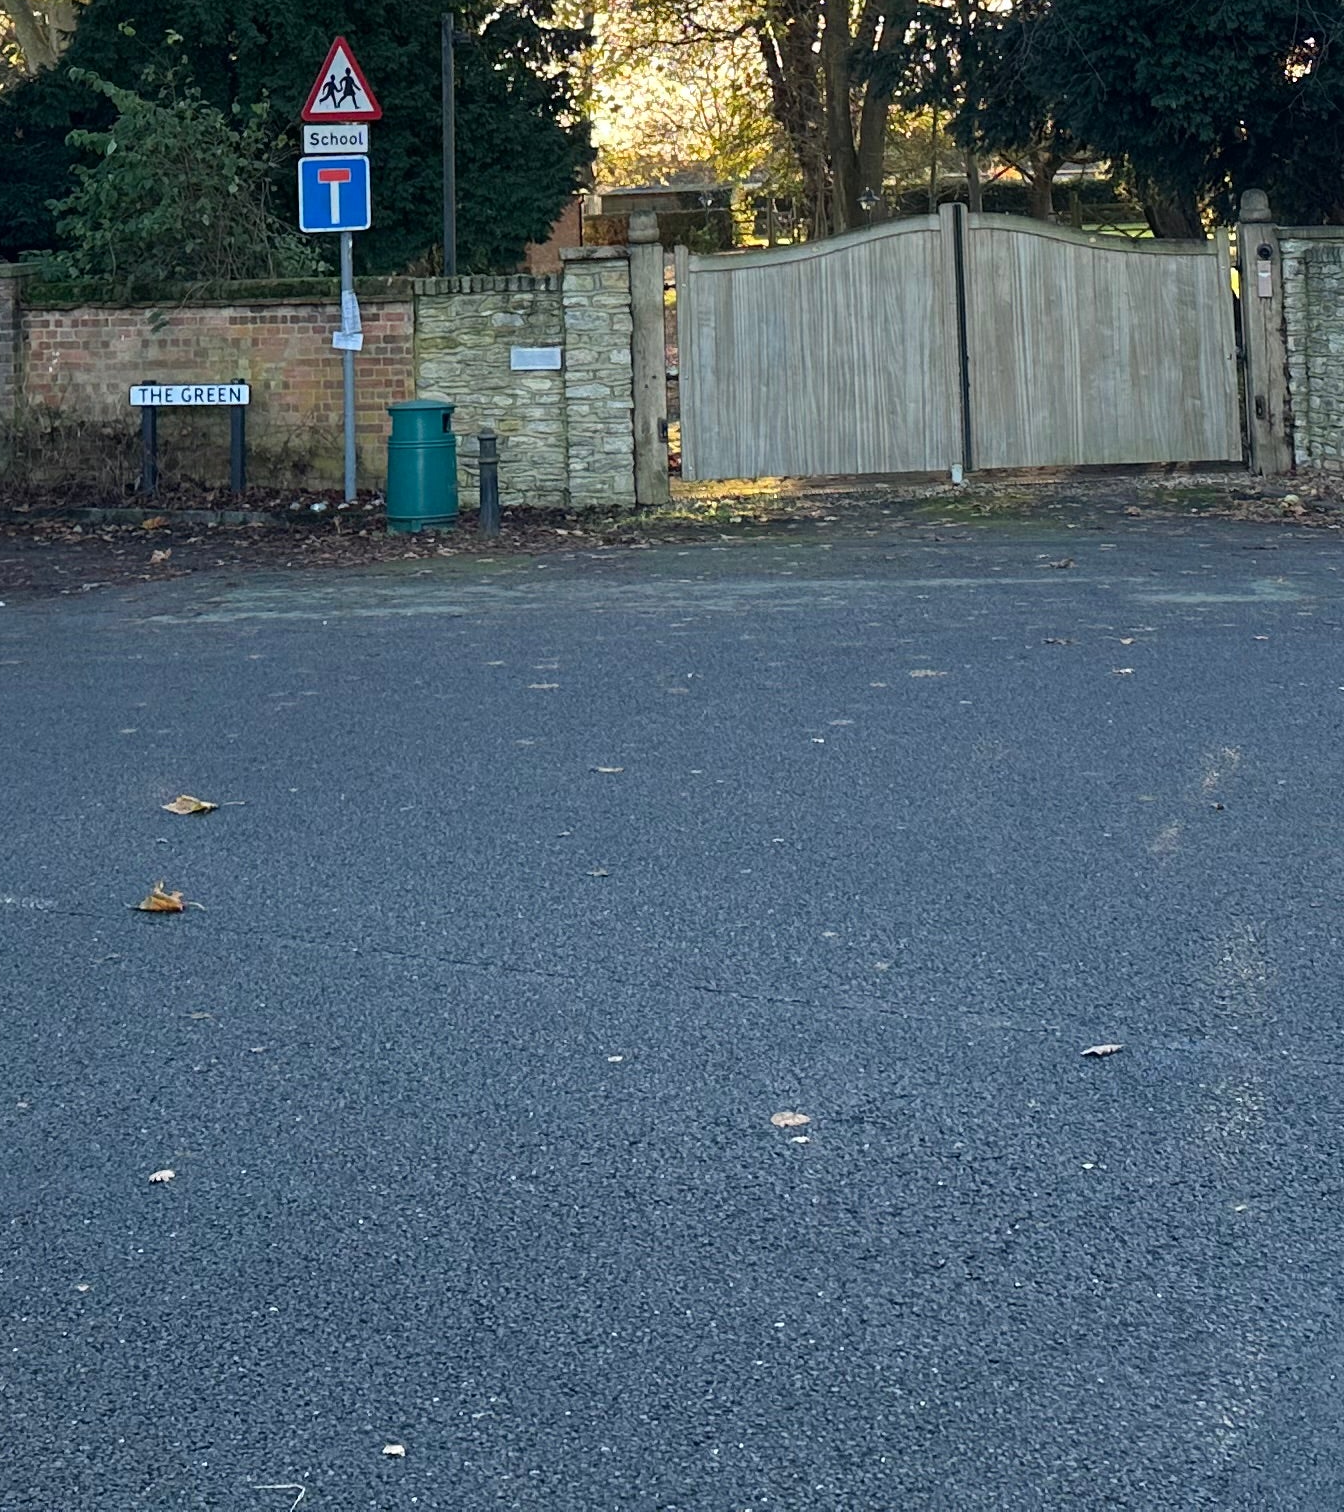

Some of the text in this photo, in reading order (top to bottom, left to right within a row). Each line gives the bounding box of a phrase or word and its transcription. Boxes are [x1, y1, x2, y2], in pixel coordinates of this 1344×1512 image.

[309, 131, 364, 146] School
[138, 388, 241, 403] THE GREEN
